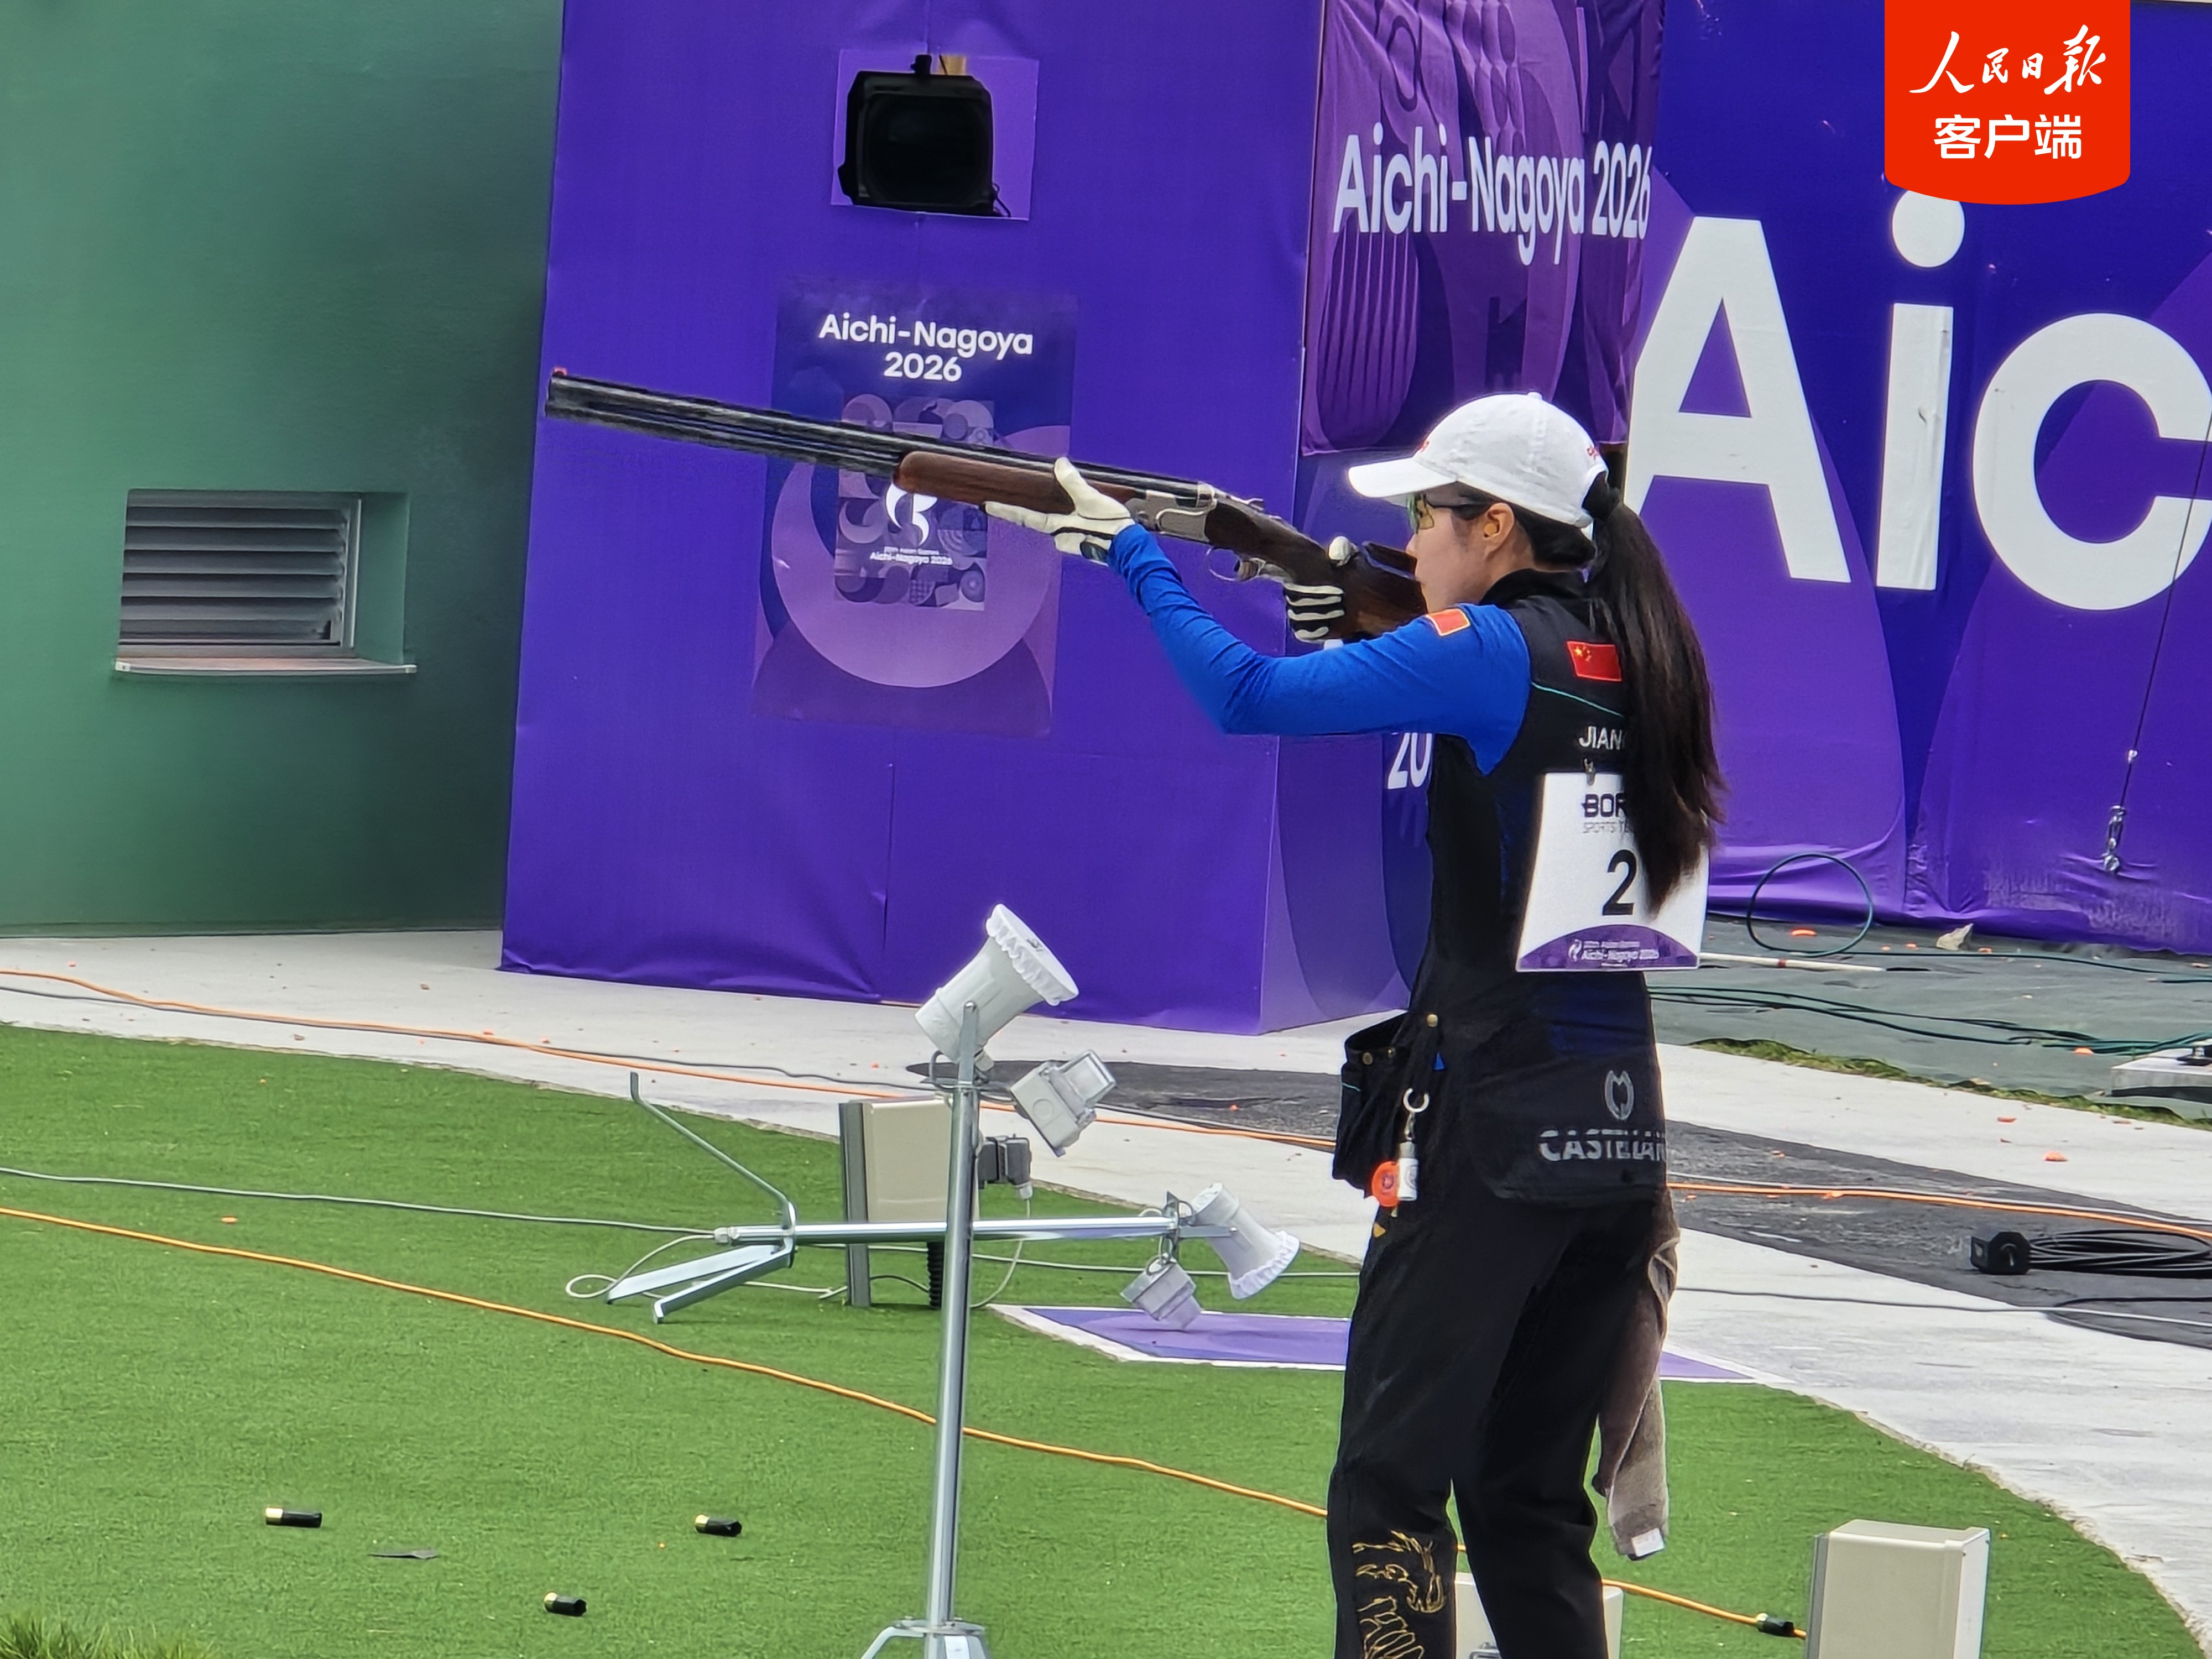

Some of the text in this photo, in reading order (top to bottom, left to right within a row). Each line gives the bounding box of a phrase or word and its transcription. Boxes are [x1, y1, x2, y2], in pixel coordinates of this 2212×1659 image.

[1333, 123, 1651, 265] Aichi-Nagoya 2026
[818, 312, 1033, 360] Aichi-Nagoya
[884, 352, 962, 382] 2026
[1624, 190, 2212, 609] Aic
[1579, 726, 1626, 750] JIAN
[1603, 850, 1636, 916] 2
